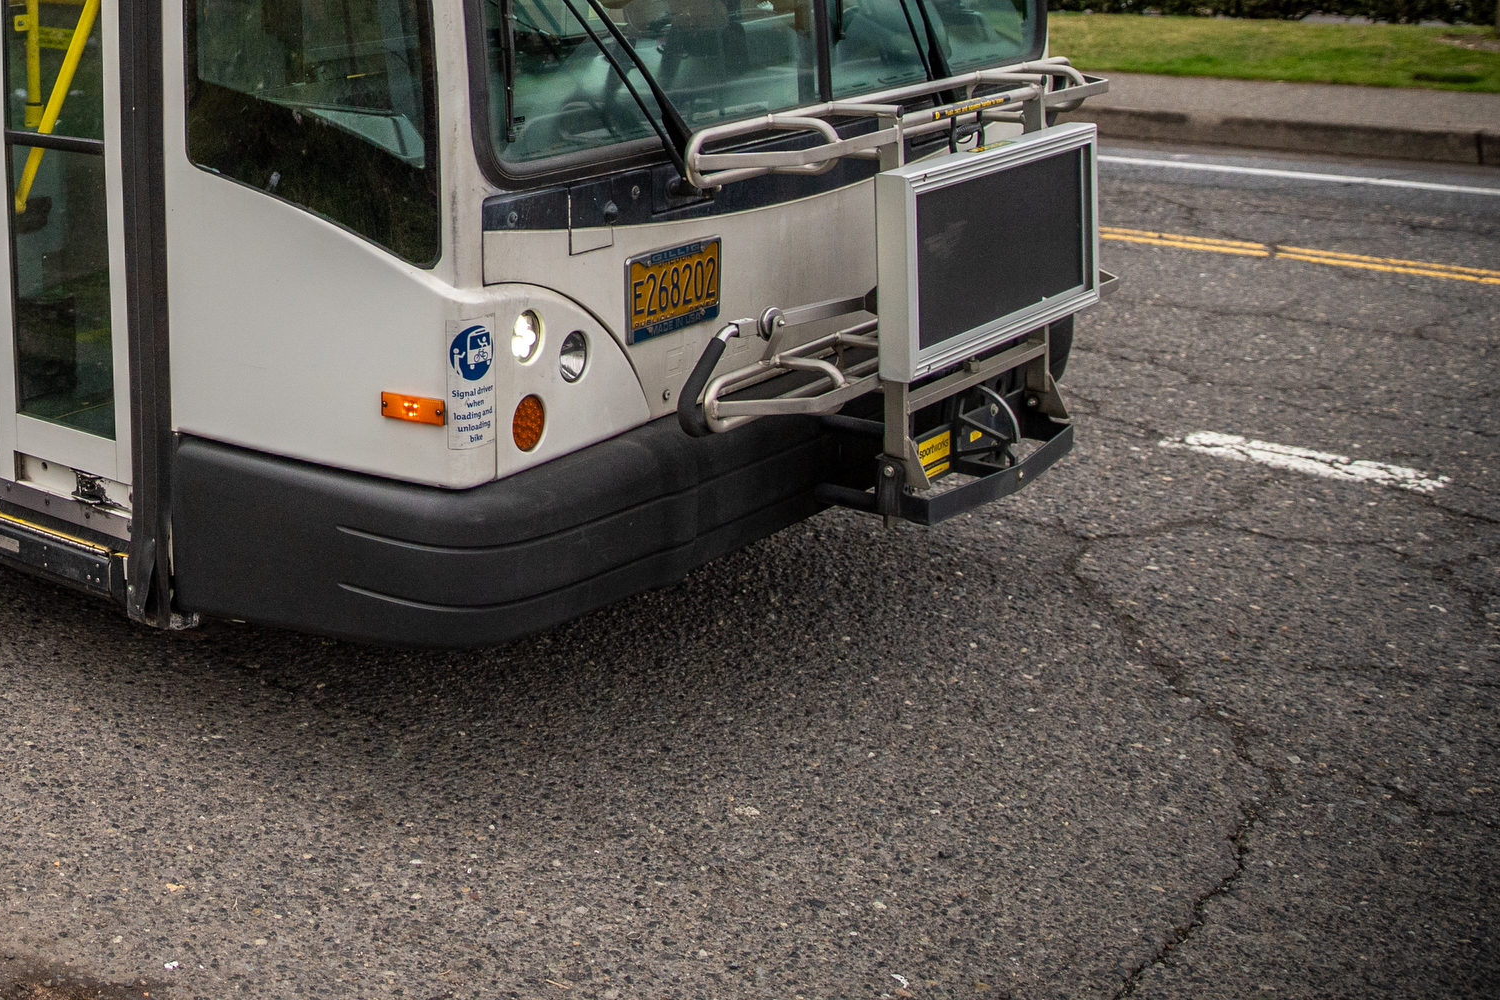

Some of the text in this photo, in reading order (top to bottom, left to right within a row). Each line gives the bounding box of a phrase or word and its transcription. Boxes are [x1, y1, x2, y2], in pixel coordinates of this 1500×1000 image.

[651, 243, 700, 262] GILLIG
[633, 256, 716, 317] E268202
[652, 320, 674, 336] MADE
[675, 317, 684, 328] IN
[451, 384, 493, 399] Signal driver
[466, 399, 485, 408] when
[453, 405, 493, 420] loading and
[457, 420, 491, 433] unloading
[469, 433, 483, 443] bike
[919, 437, 949, 460] sportworks
